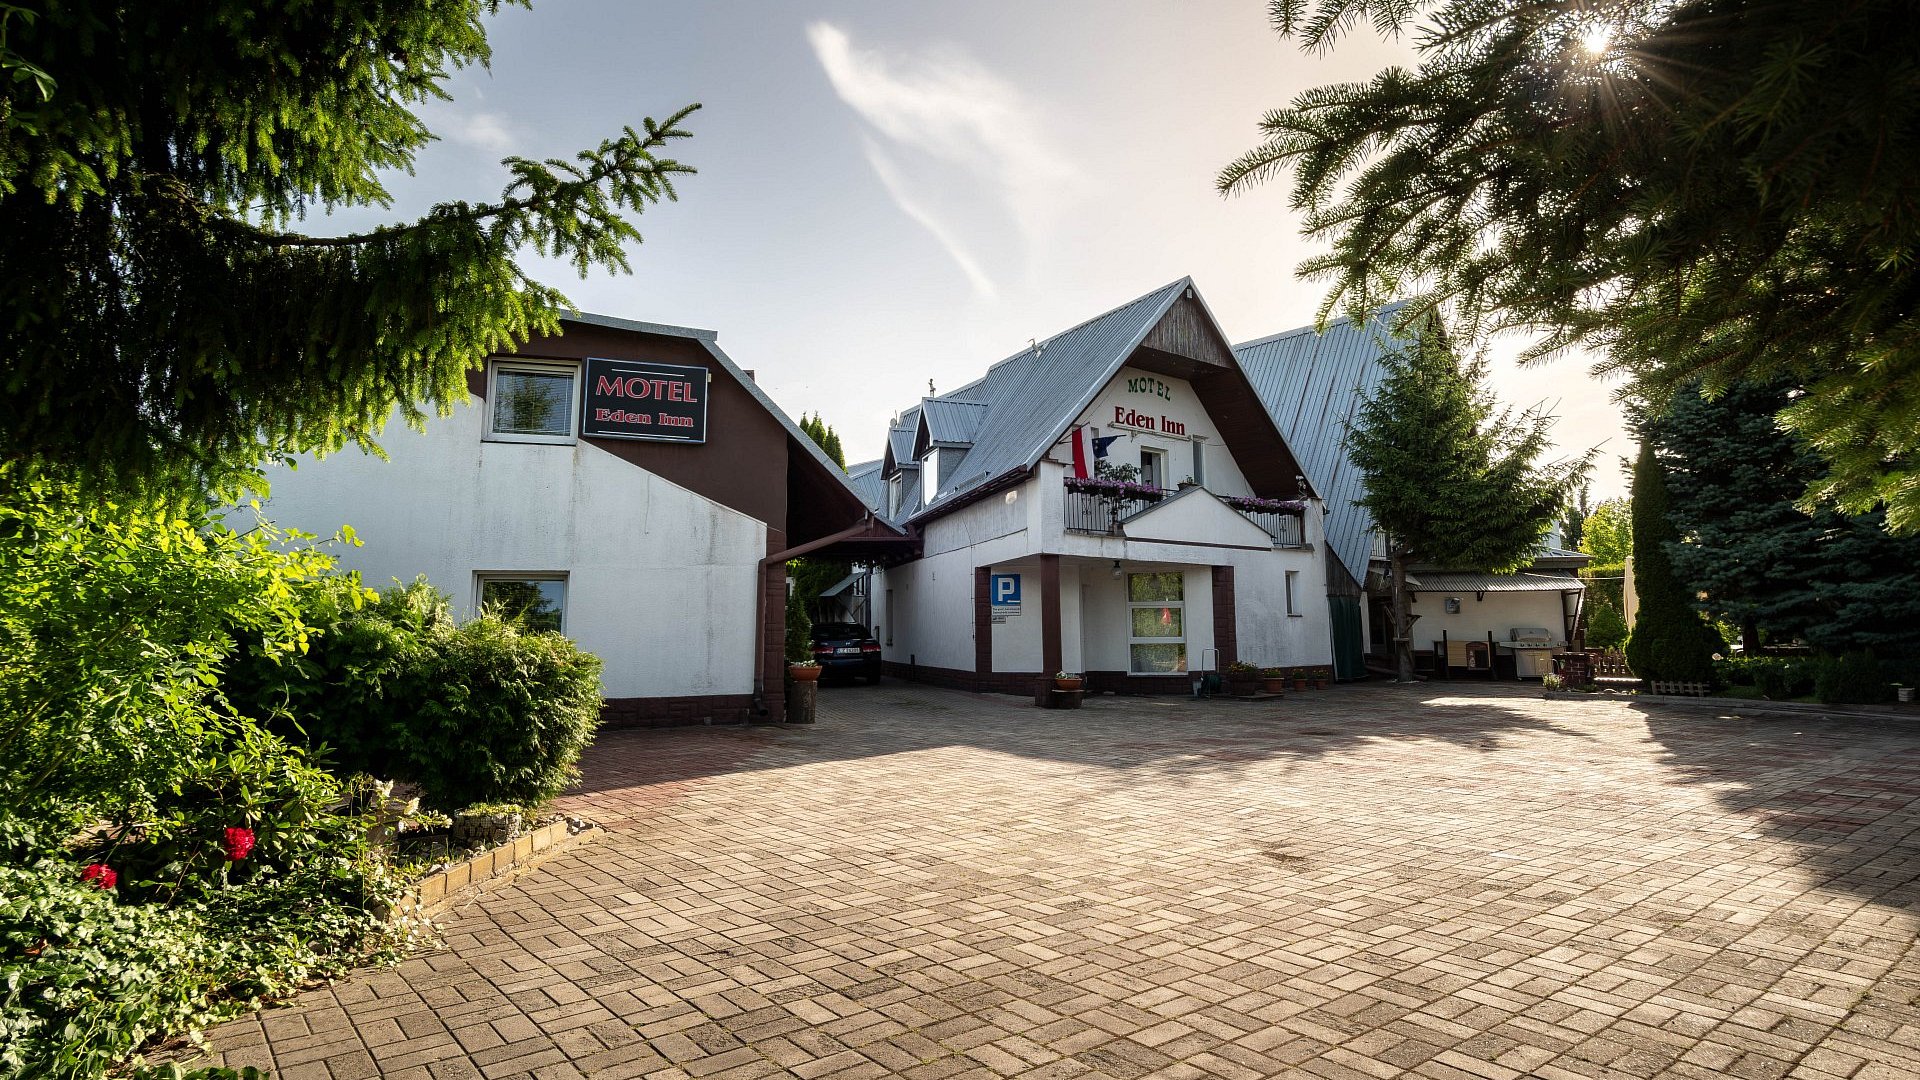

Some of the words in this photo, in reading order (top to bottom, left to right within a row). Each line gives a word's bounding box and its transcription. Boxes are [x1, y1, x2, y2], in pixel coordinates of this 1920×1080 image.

[596, 375, 698, 403] MOTEL
[1128, 377, 1171, 402] MOTEL
[595, 408, 652, 425] Eden
[658, 412, 694, 428] Inn
[1114, 406, 1155, 430] Eden
[1161, 415, 1186, 436] Inn
[997, 577, 1015, 602] P
